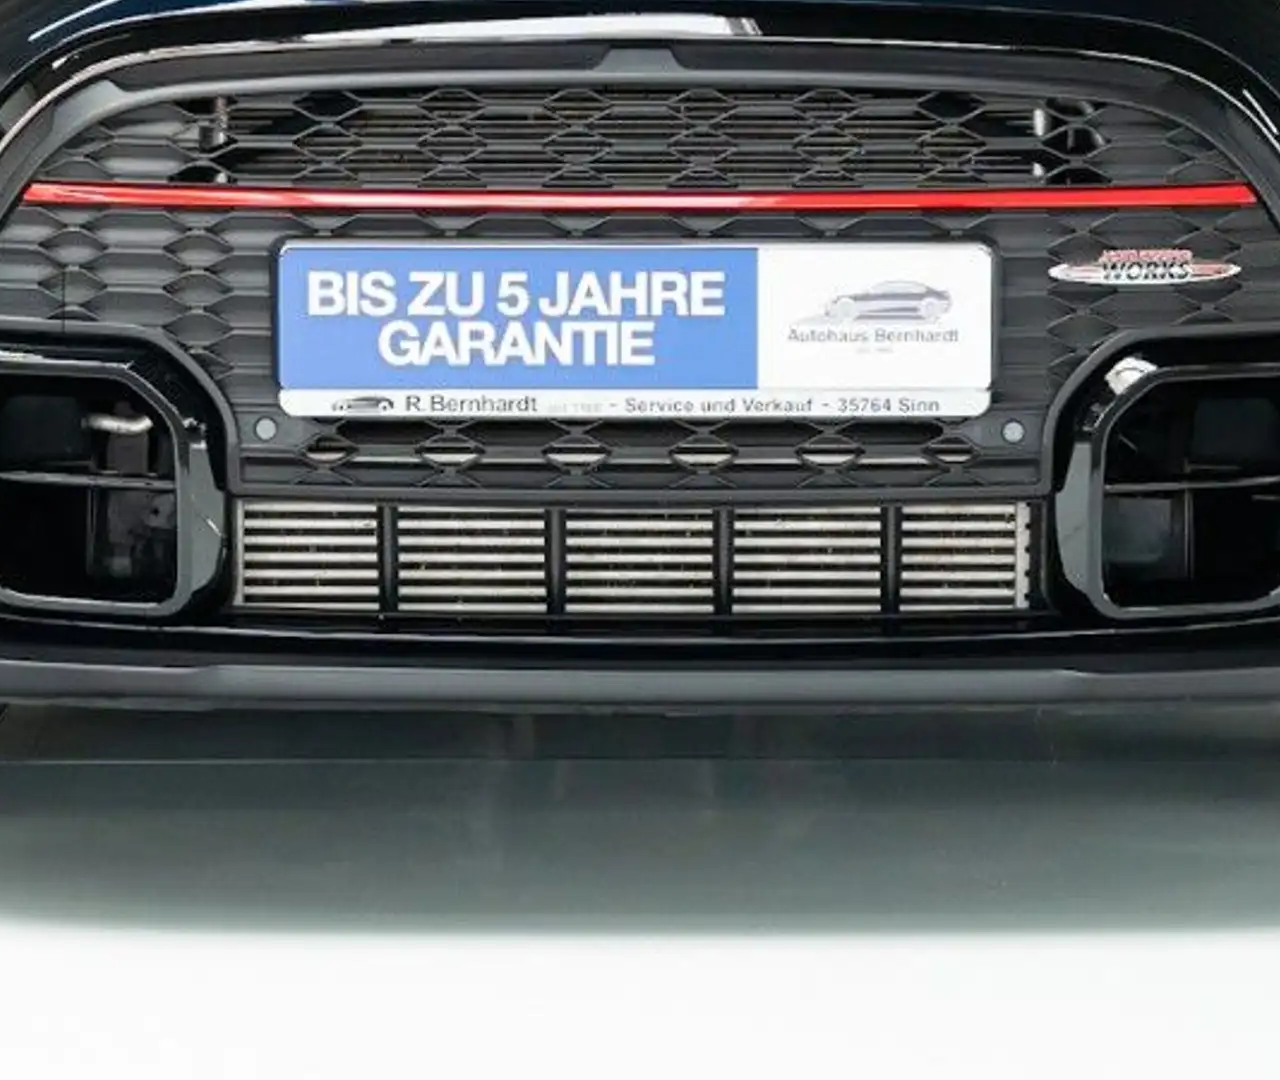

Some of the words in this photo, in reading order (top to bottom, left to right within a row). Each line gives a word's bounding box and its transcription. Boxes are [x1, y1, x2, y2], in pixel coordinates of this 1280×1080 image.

[1102, 261, 1190, 280] WORKS
[308, 271, 396, 317] BIS
[407, 271, 482, 317] ZU
[496, 271, 530, 317] 5
[540, 271, 725, 317] JAHRE
[378, 320, 656, 366] GARANTIE
[787, 327, 869, 343] Autohaus
[874, 327, 959, 343] Bernhardt
[430, 394, 538, 412] Bernhardt
[624, 397, 694, 413] Service
[702, 397, 739, 413] und
[742, 397, 813, 413] Verkauf
[837, 397, 892, 413] 35764
[898, 397, 941, 413] Sinn
